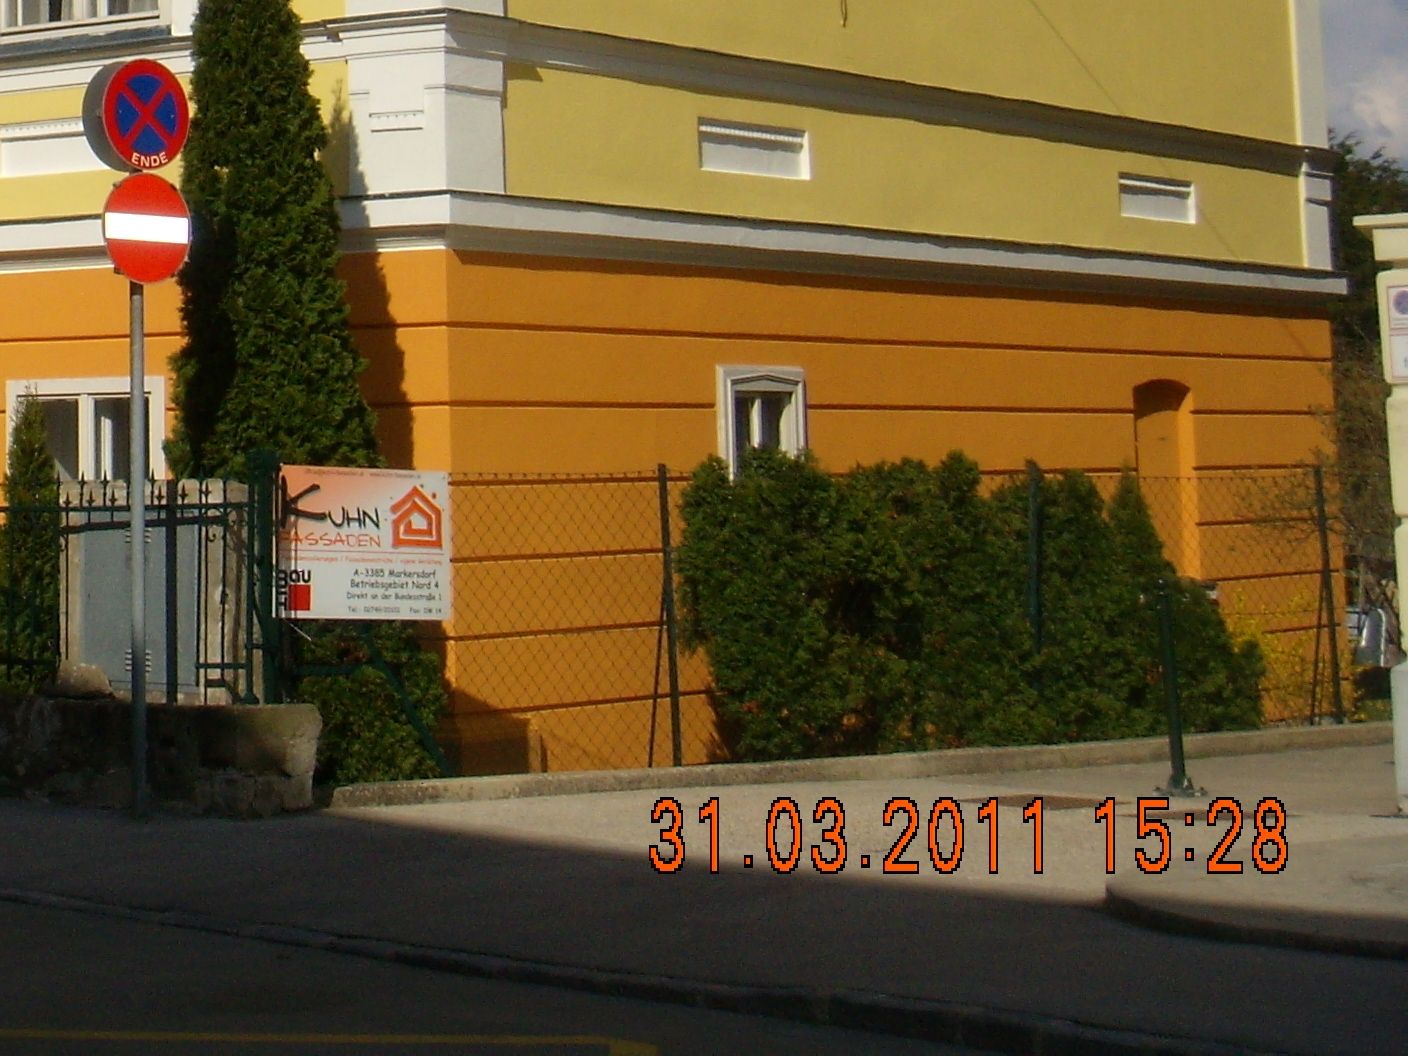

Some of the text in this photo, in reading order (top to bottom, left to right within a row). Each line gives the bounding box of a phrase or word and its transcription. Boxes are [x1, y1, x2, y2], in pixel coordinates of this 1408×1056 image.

[131, 151, 169, 167] ENDE
[279, 474, 380, 530] KUHN
[388, 568, 437, 579] Markersdorf
[350, 579, 409, 591] Betriebsgebiet
[411, 580, 432, 590] Nord
